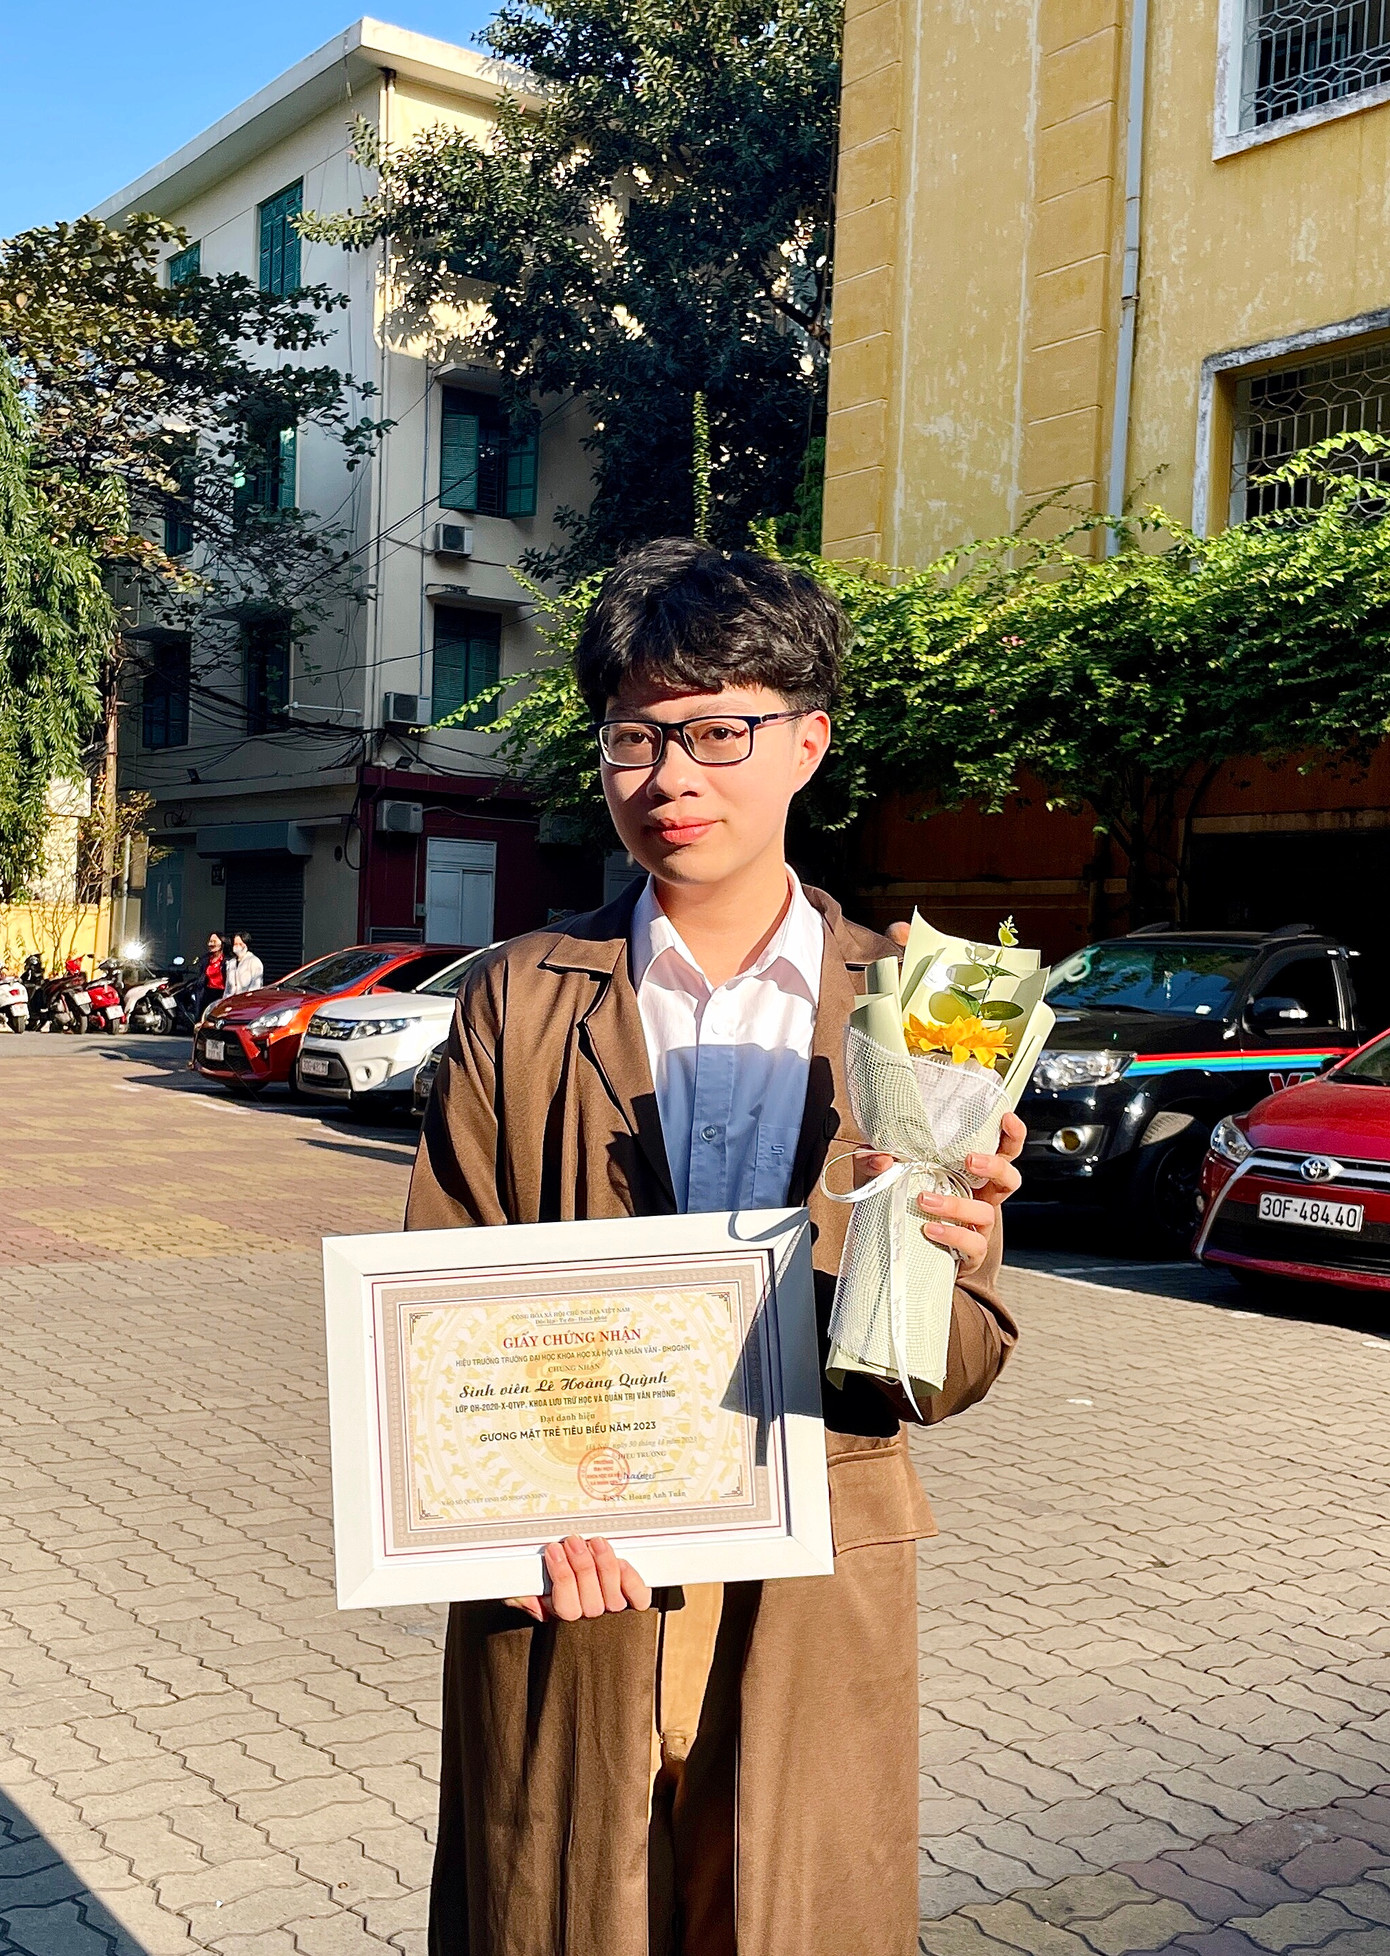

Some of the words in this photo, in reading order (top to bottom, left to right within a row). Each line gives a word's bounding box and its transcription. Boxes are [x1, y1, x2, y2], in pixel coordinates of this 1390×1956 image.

[1262, 1197, 1357, 1228] 30F-484.40
[503, 1331, 538, 1349] GIẤY
[543, 1330, 595, 1346] CHỨNG
[600, 1326, 642, 1343] NHẬN
[456, 1358, 471, 1367] HIỆU
[530, 1354, 540, 1363] ĐẠI
[542, 1353, 556, 1362] HỌC
[557, 1352, 574, 1360] KHOA
[576, 1351, 590, 1359] HỌC
[602, 1348, 613, 1357] HỘI
[614, 1347, 623, 1355] VÀ
[624, 1346, 643, 1355] NHÂN
[643, 1345, 657, 1354] VĂN
[459, 1384, 495, 1398] Sinh
[500, 1383, 531, 1395] viên
[534, 1379, 555, 1392] Lê
[560, 1377, 614, 1390] Hoàng
[619, 1371, 668, 1388] Quỳnh
[456, 1404, 468, 1413] LỚP
[529, 1399, 548, 1408] KHOA
[549, 1397, 562, 1406] LƯU
[578, 1394, 592, 1405] HỌC
[594, 1393, 603, 1403] VÀ
[604, 1391, 623, 1402] QUẢN
[625, 1392, 635, 1402] TRỊ
[637, 1390, 651, 1400] VĂN
[652, 1388, 676, 1399] PHÒNG
[540, 1414, 555, 1424] Đạt
[556, 1414, 577, 1422] danh
[579, 1412, 596, 1422] hiệu
[480, 1430, 517, 1442] GƯƠNG
[520, 1429, 540, 1441] MẶT
[543, 1425, 561, 1437] TRẺ
[563, 1424, 583, 1436] TIÊU
[586, 1421, 607, 1434] BIỂU
[609, 1420, 631, 1432] NĂM
[633, 1420, 656, 1431] 2023
